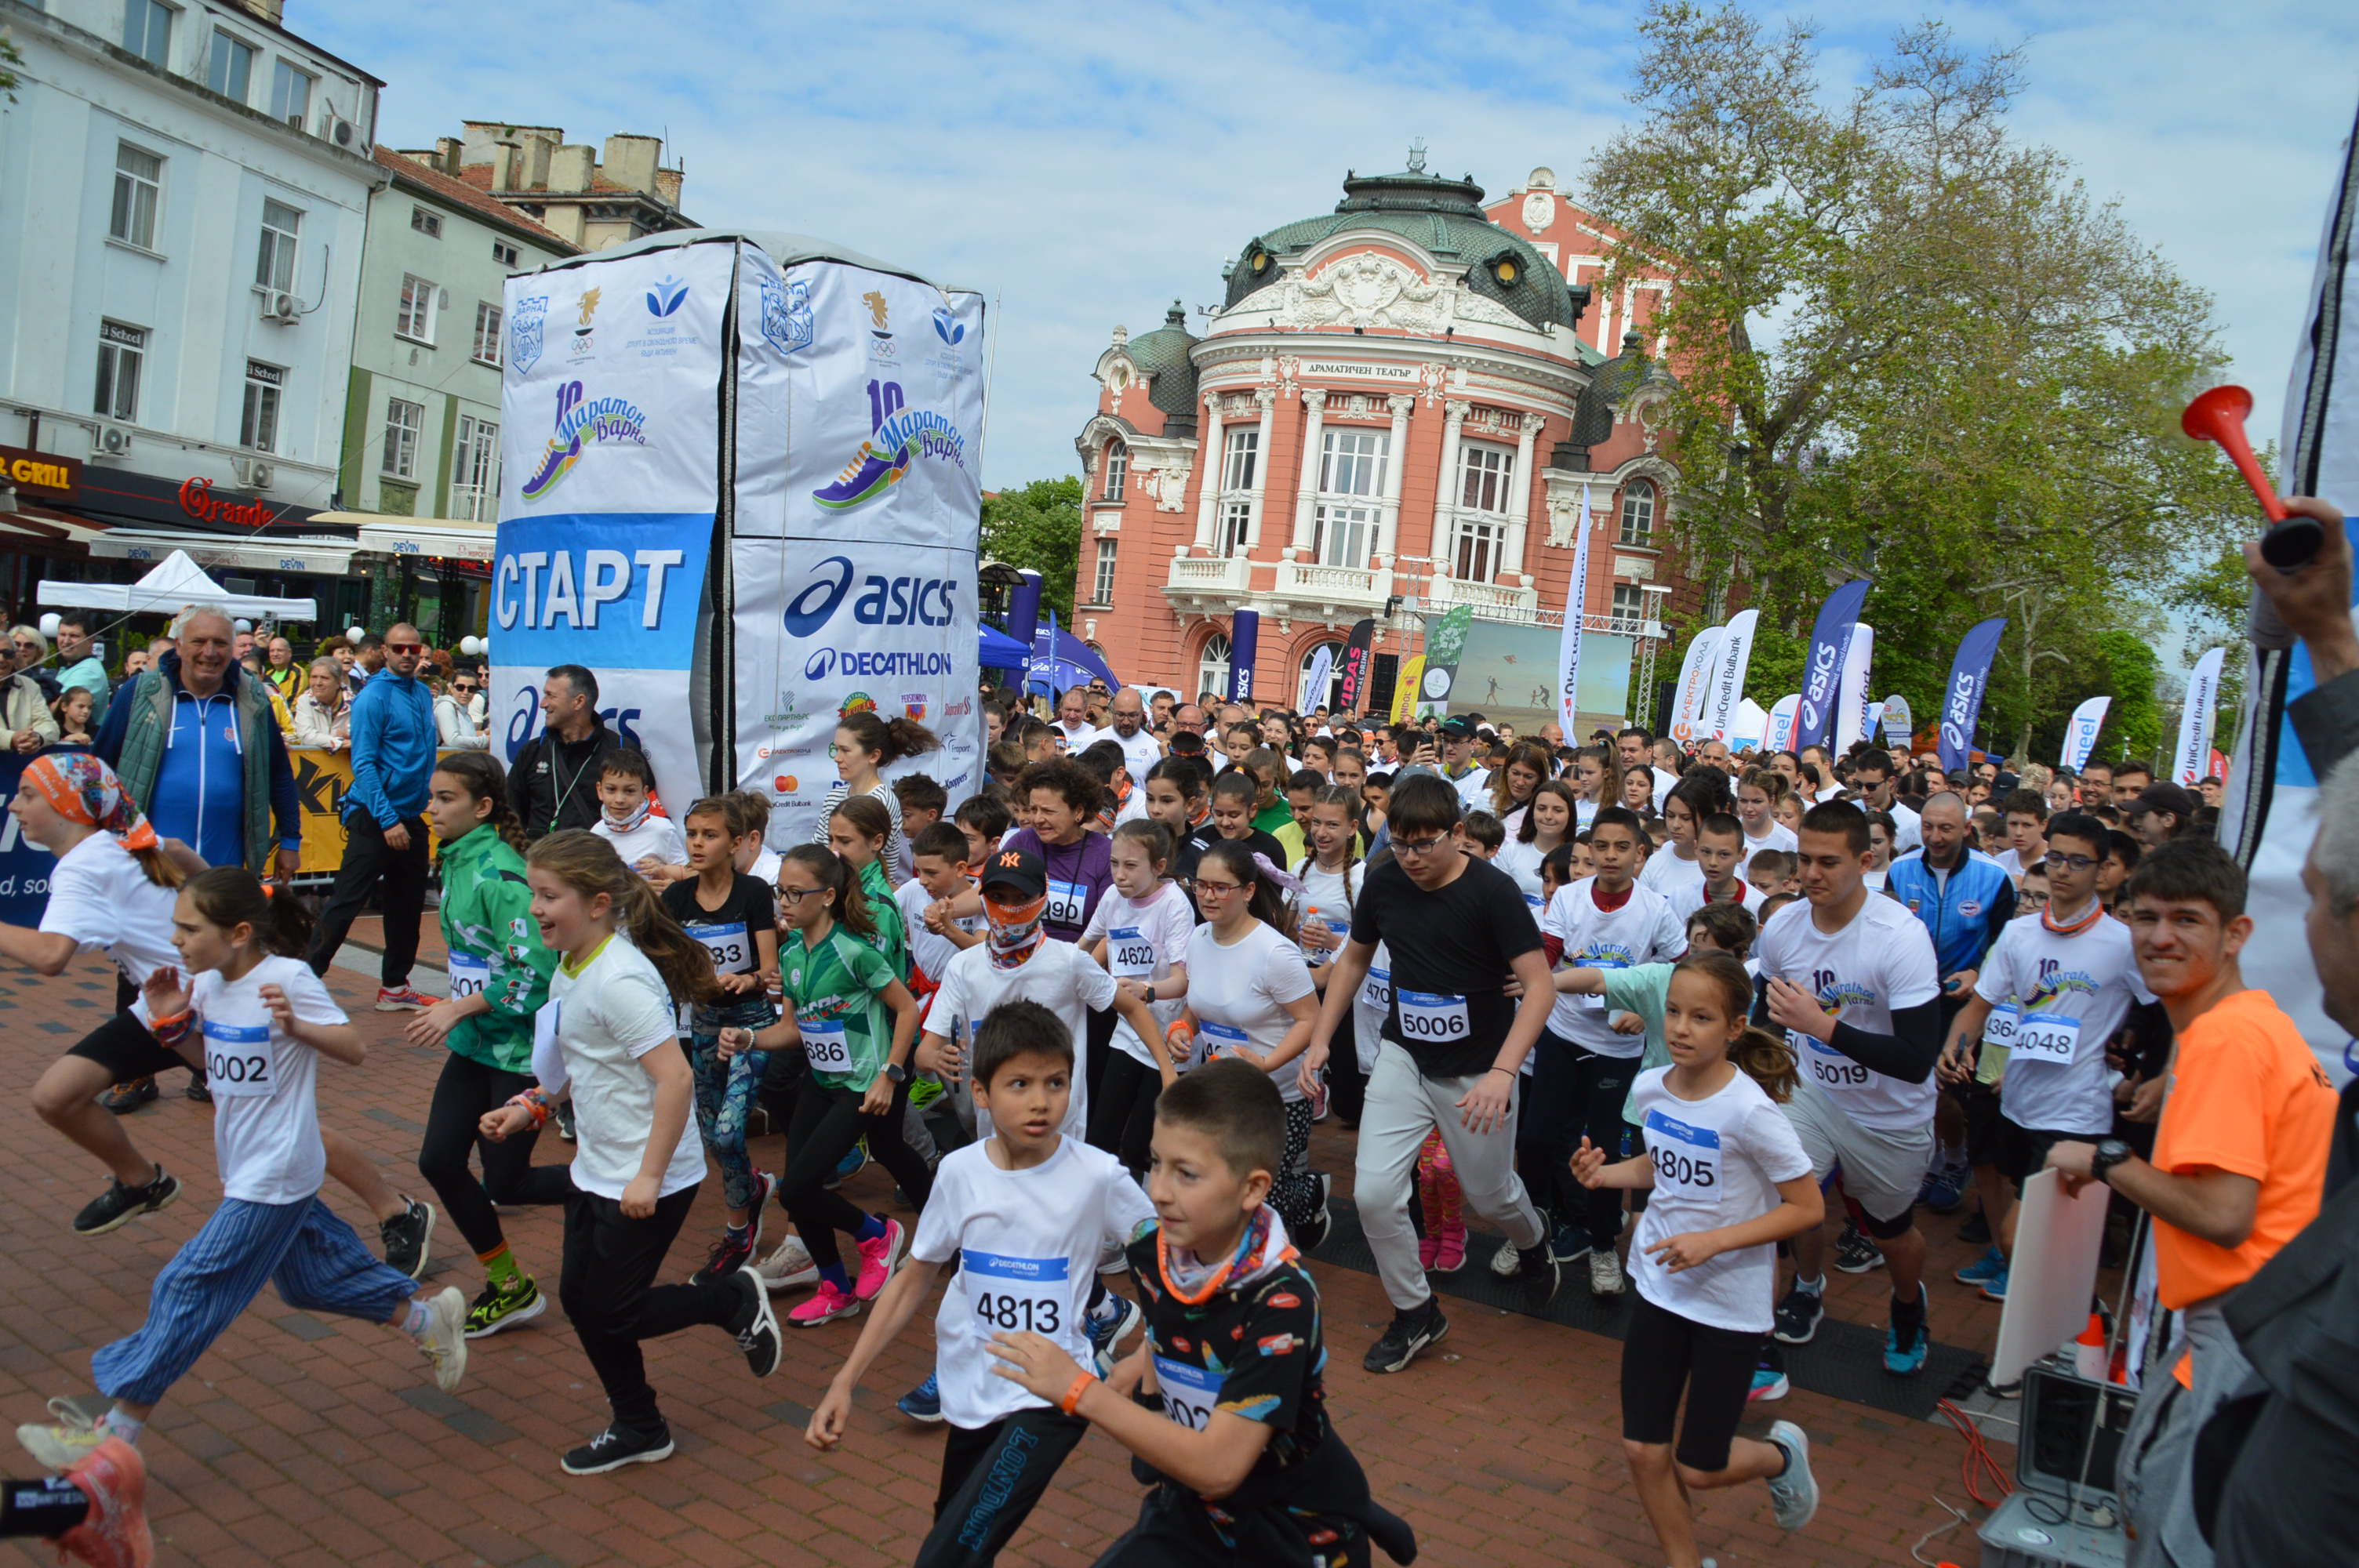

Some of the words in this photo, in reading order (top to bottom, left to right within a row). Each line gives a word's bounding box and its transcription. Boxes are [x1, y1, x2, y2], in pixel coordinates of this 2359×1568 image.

[110, 325, 141, 345] School
[254, 365, 280, 383] School
[1308, 364, 1372, 375] ДРАМАТИЧЕН
[1376, 367, 1412, 377] ТЕАТЪР
[555, 380, 583, 434] 10
[560, 397, 645, 446] Маратон
[867, 379, 904, 439] 10
[593, 416, 645, 445] Варна
[881, 410, 965, 458] Маратон
[919, 430, 964, 469] Варна
[11, 459, 71, 490] GRILL
[179, 476, 274, 527] Grande
[128, 547, 151, 559] DEVIN
[393, 540, 420, 554] DEVIN
[280, 558, 304, 570] DEVIN
[496, 550, 684, 630] СТАРТ
[841, 652, 951, 676] DECATHLON
[1359, 649, 1369, 677] DRINK
[1723, 636, 1743, 680] Bulbank
[1714, 681, 1733, 729] UniCredit
[2186, 720, 2202, 769] UniCredit
[2194, 675, 2209, 720] Bulbank
[951, 745, 971, 753] Fraport
[944, 771, 969, 791] Knoppers
[1118, 946, 1154, 966] 4622
[1404, 1013, 1463, 1036] 5006
[2016, 1032, 2070, 1054] 4048
[207, 1051, 268, 1083] 4002
[1814, 1059, 1868, 1084] 5019
[1650, 1145, 1714, 1187] 4805
[999, 1259, 1040, 1272] DECATHLON
[977, 1292, 1060, 1334] 4813
[958, 1426, 1039, 1552] LONDON
